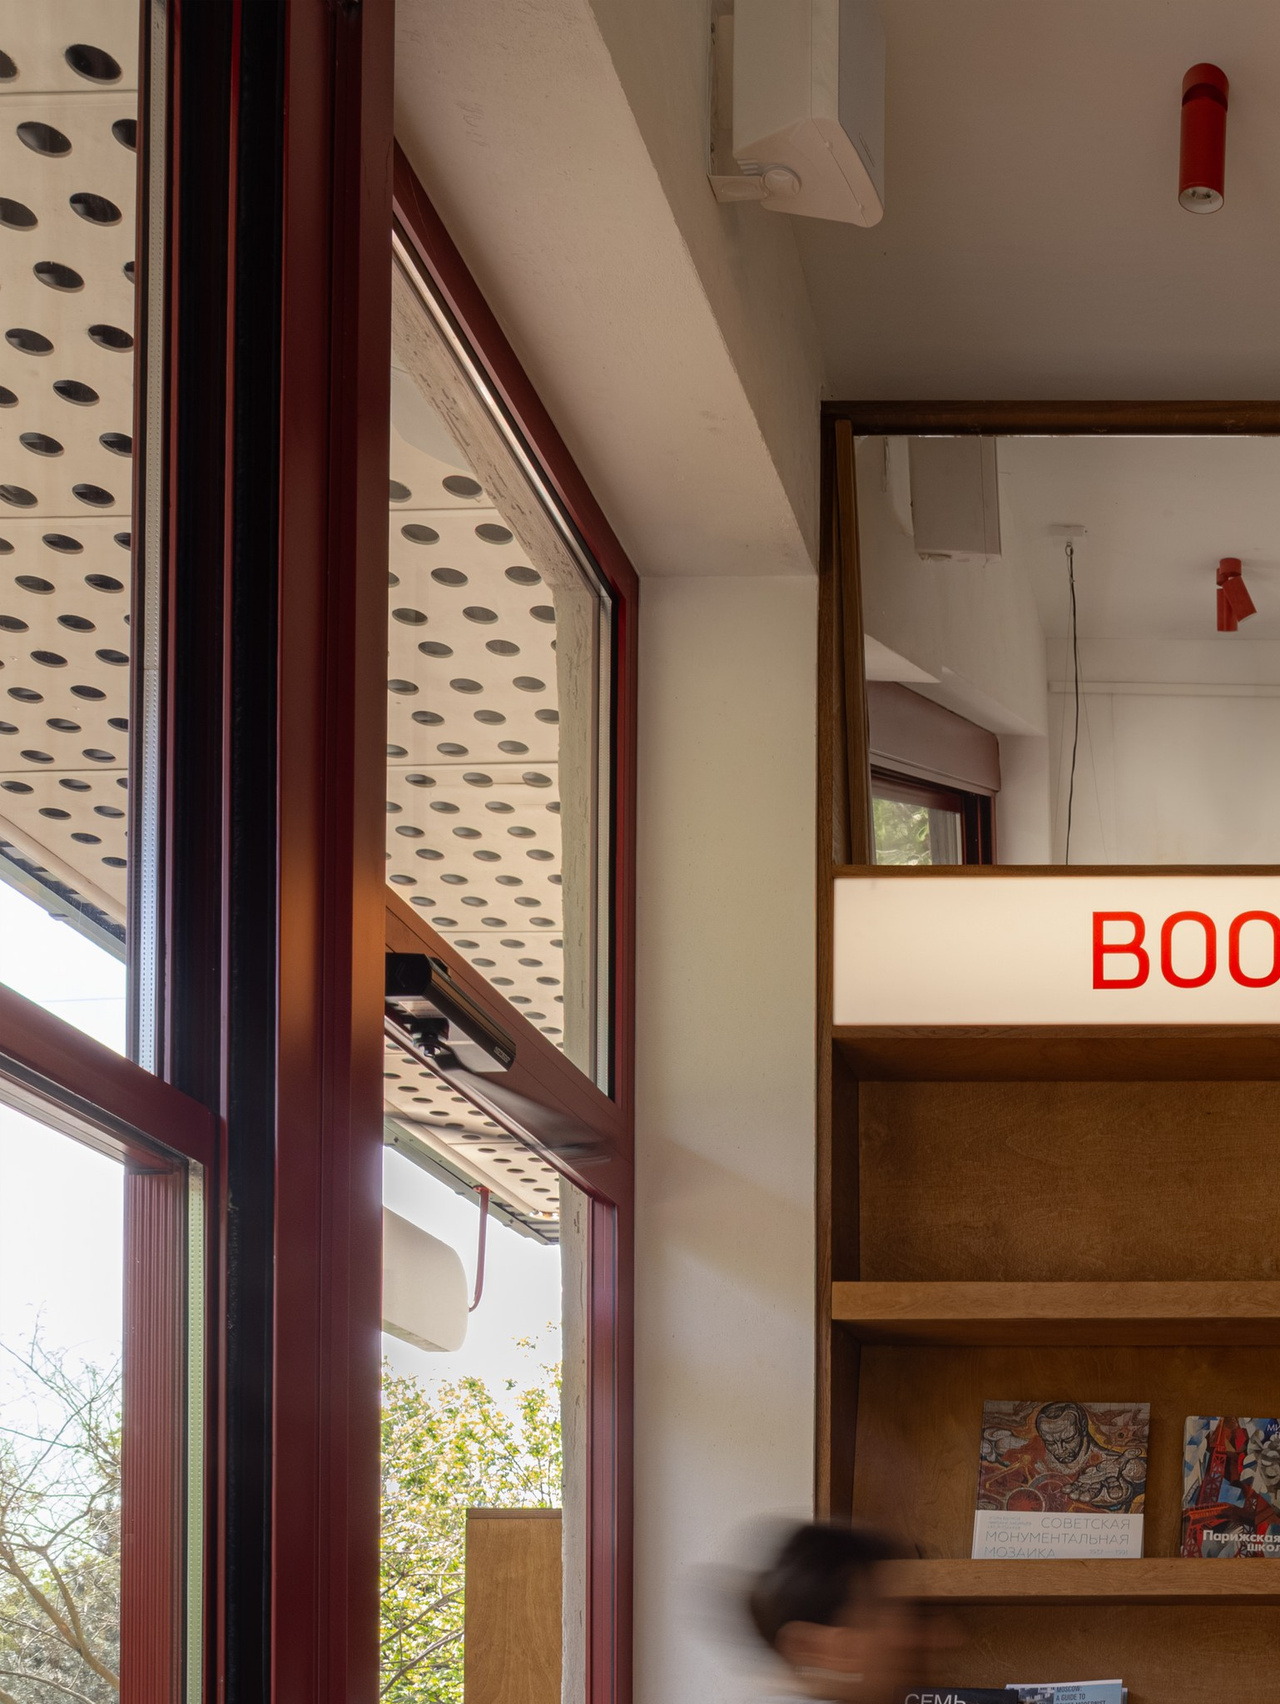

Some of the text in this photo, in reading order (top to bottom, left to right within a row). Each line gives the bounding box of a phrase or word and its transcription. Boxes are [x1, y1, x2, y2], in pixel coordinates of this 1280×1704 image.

[1040, 1516, 1130, 1530] СОВЕТСКАЯ
[985, 1530, 1129, 1545] МОНУМЕНТАЛЬНАЯ
[1202, 1529, 1280, 1543] Парижская
[984, 1546, 1056, 1558] МОЗАИКА
